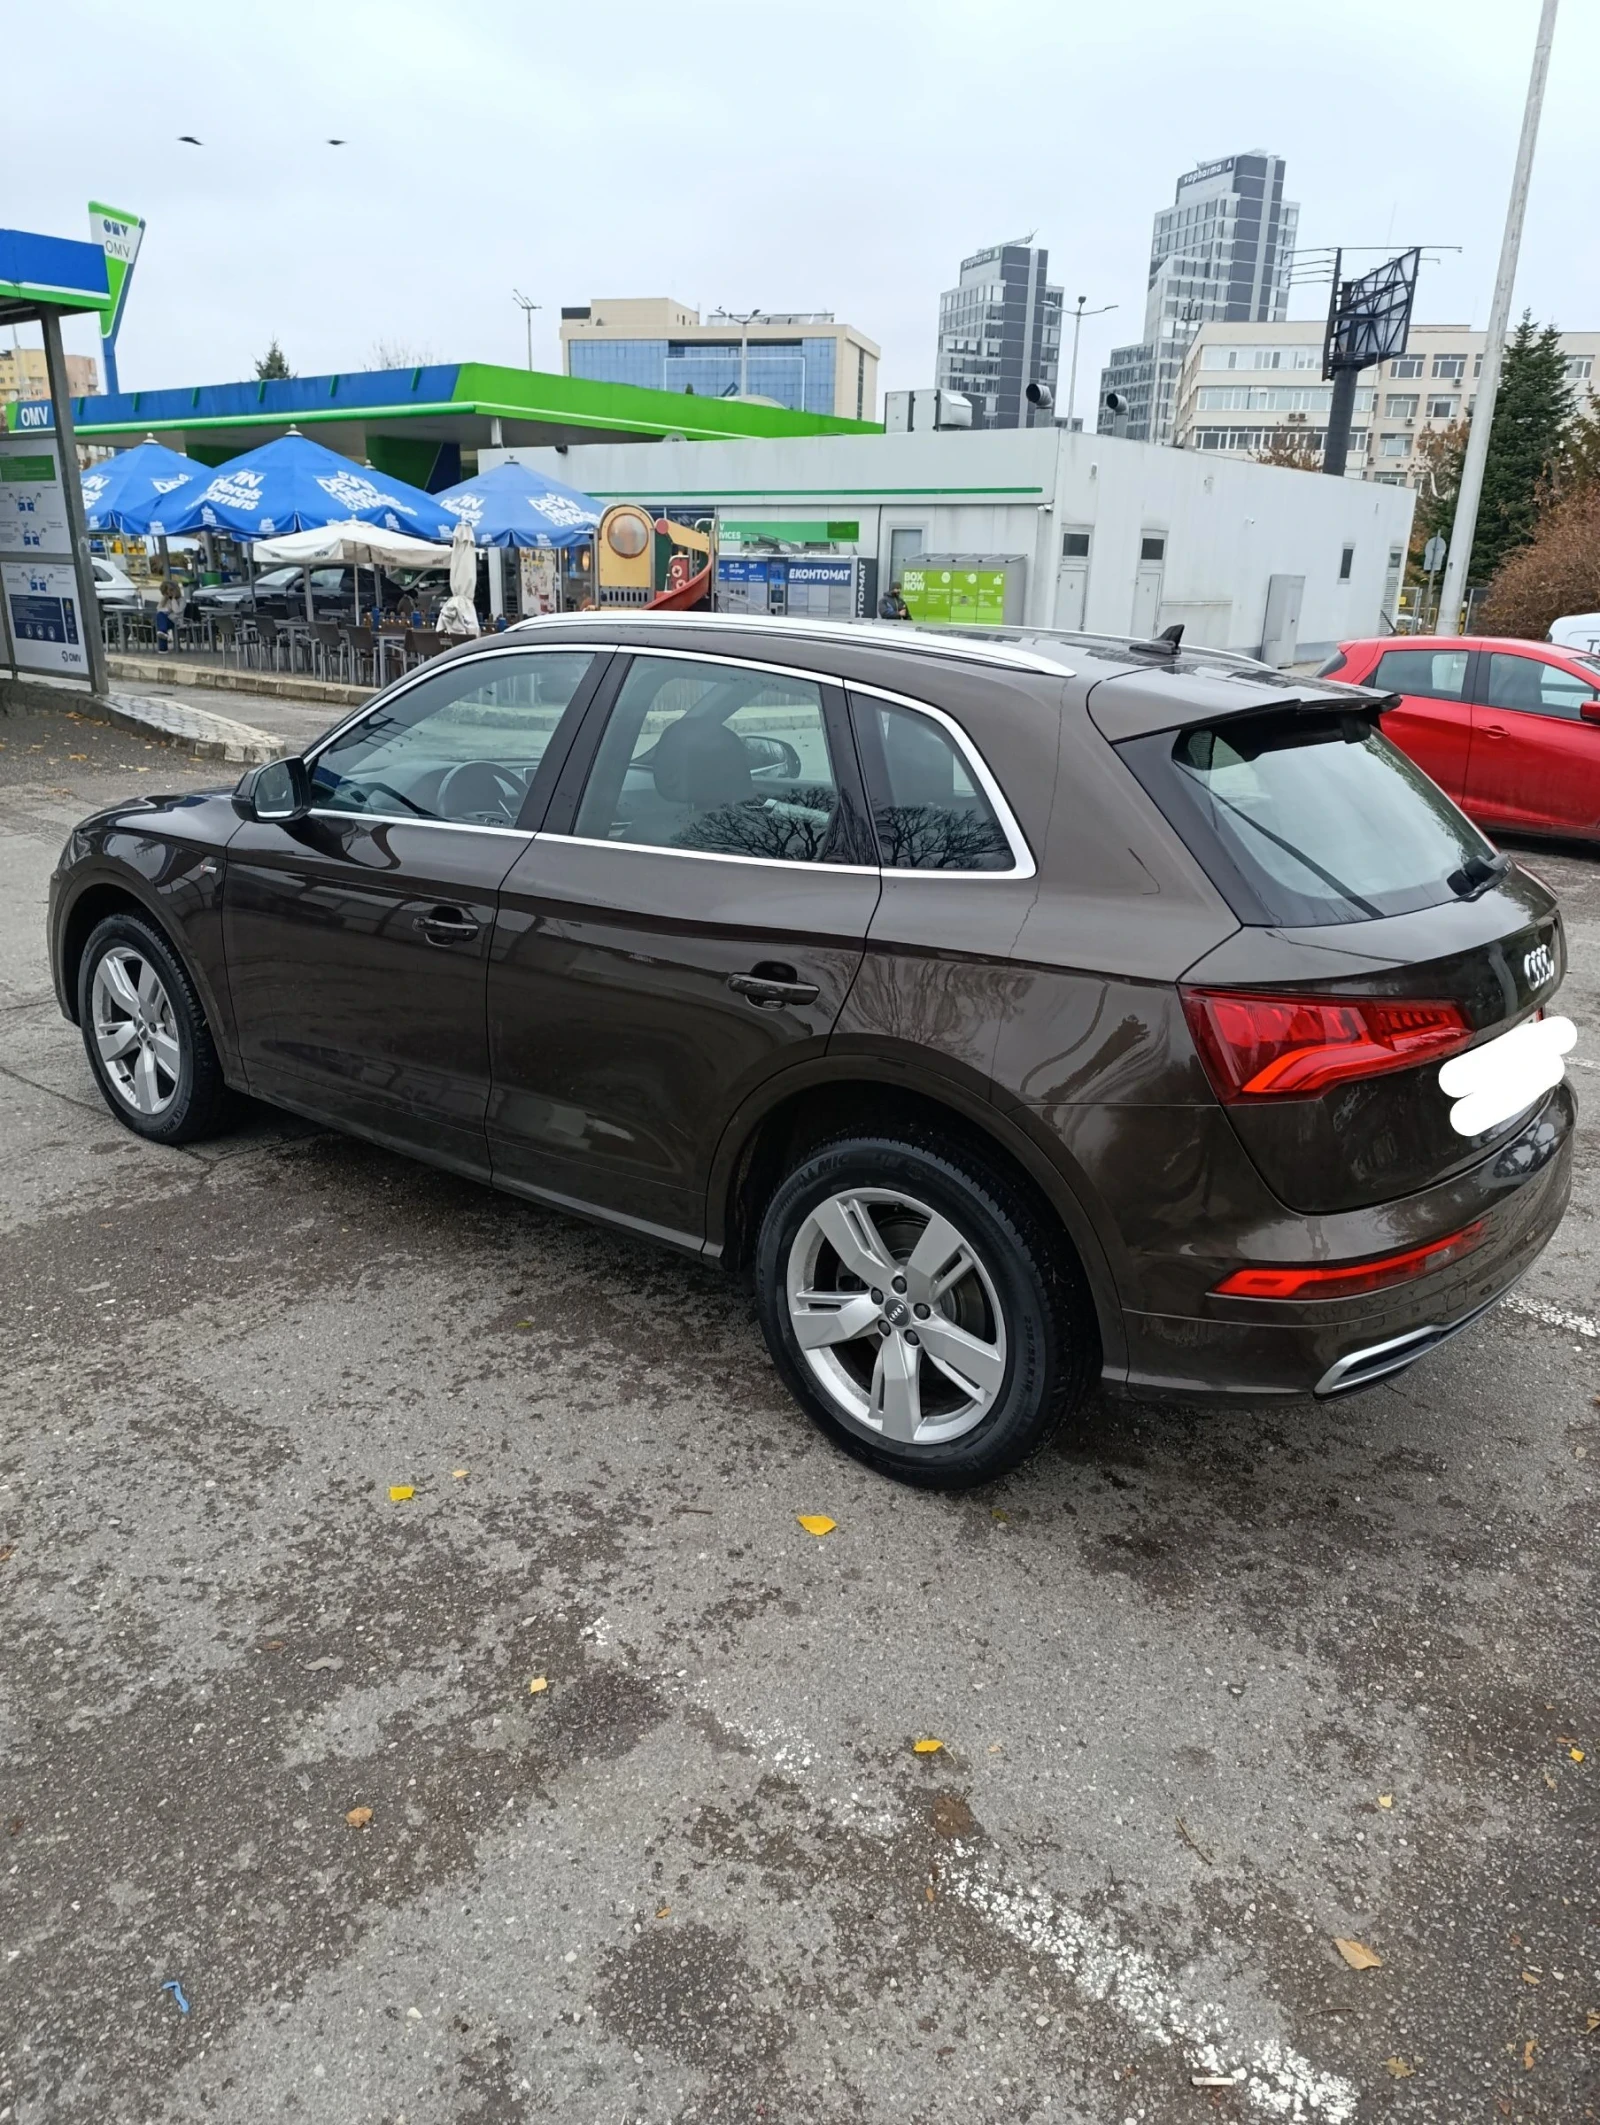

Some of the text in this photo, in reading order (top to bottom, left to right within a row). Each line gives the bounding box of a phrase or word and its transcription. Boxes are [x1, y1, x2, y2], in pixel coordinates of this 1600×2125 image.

[105, 240, 130, 258] OMV
[21, 406, 48, 427] OMV
[719, 531, 741, 540] VICES
[788, 568, 851, 581] ЕКОНТОМАТ
[904, 571, 924, 582] BOX
[857, 561, 866, 618] НТОМАТ
[903, 581, 925, 591] NOW
